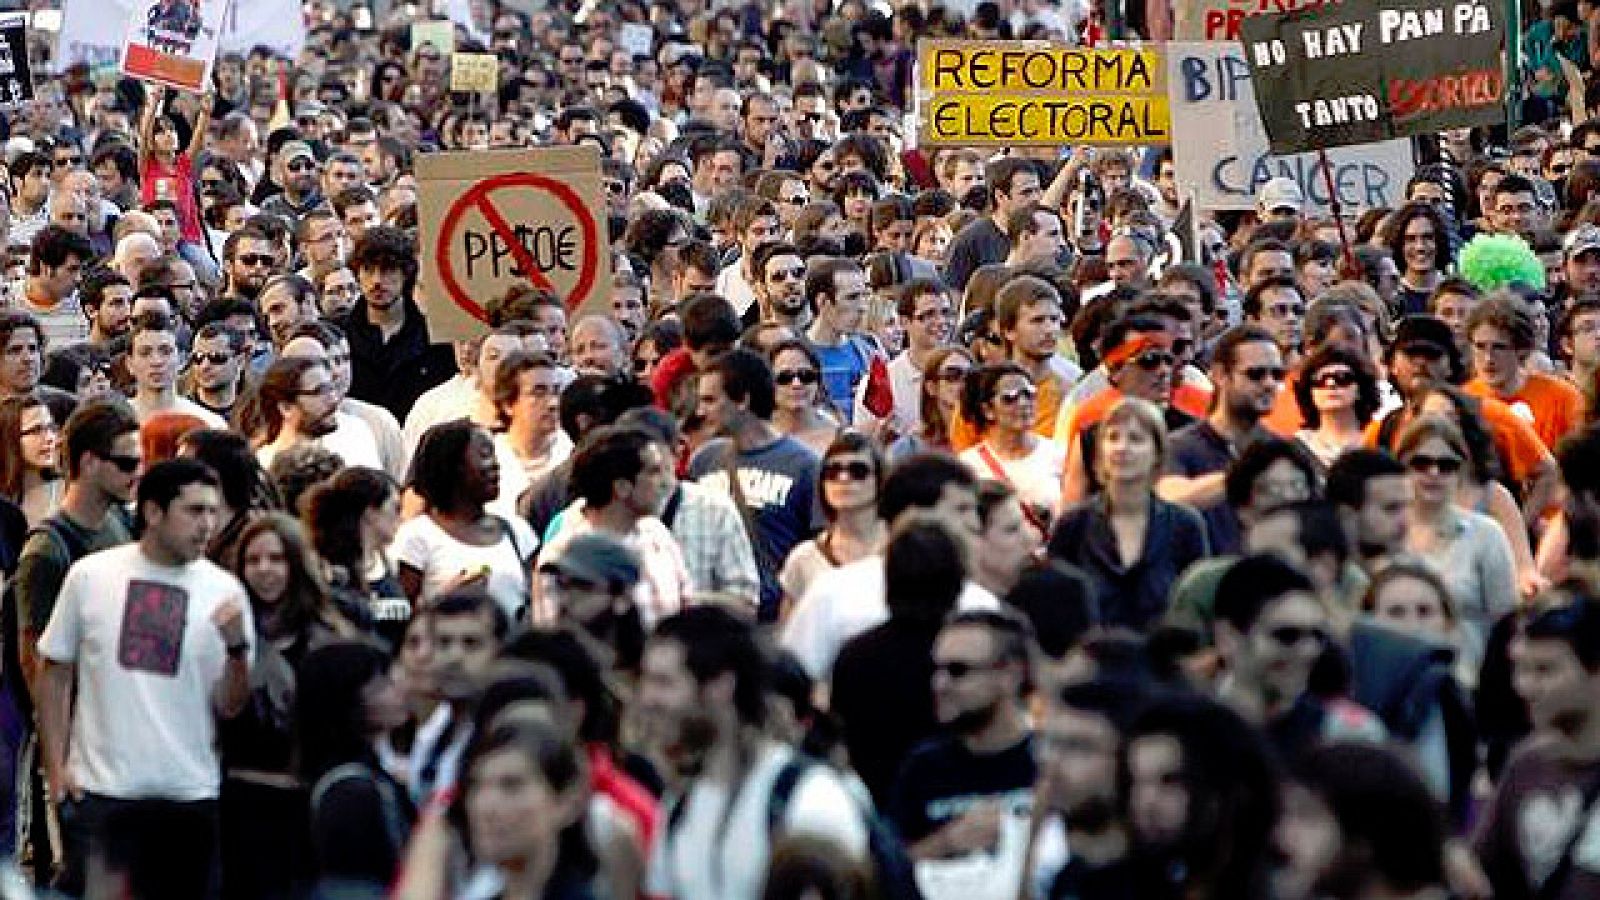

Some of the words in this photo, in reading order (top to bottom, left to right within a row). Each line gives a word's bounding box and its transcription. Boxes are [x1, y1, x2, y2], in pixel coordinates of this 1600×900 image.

[1253, 40, 1286, 66] NO
[1302, 22, 1362, 58] HAY
[1379, 8, 1445, 43] PAN
[934, 49, 1150, 88] REFORMA
[934, 101, 1166, 138] ELECTORAL
[1295, 94, 1379, 128] TANTO
